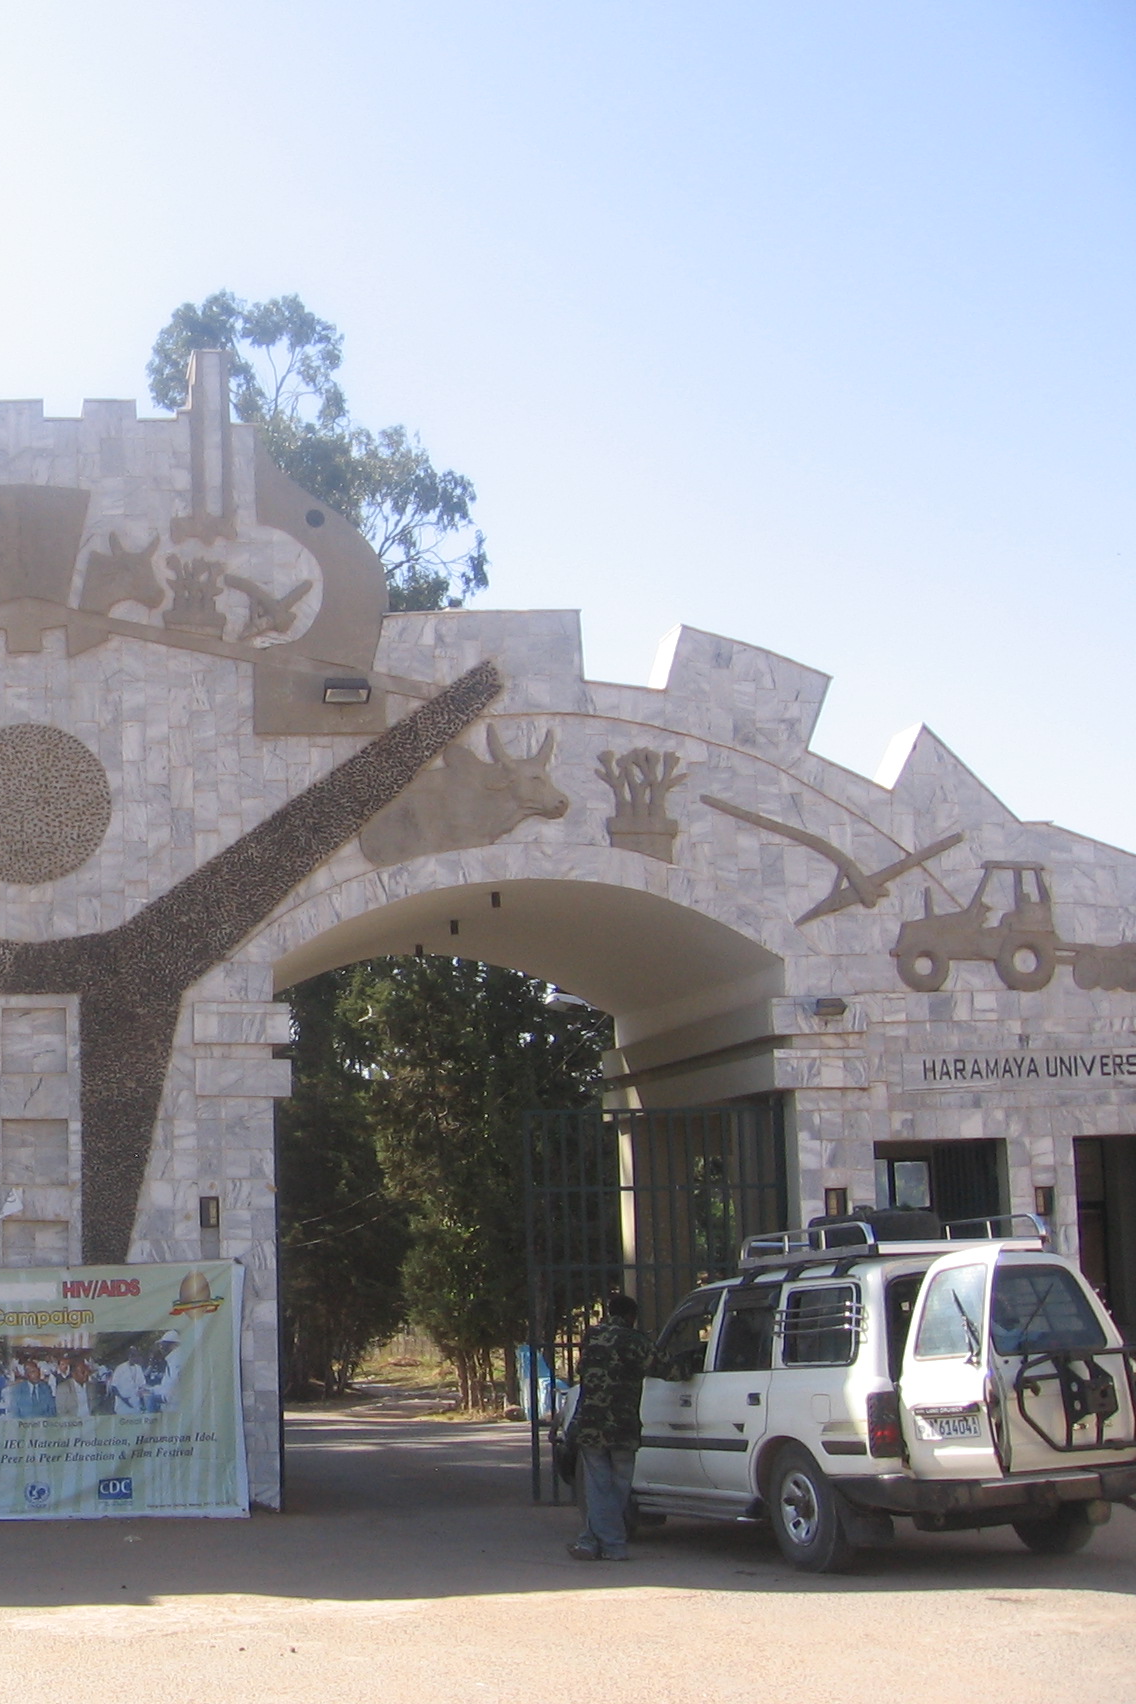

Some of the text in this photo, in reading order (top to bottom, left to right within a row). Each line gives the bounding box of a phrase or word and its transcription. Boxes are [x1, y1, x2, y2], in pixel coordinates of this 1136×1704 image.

[922, 1056, 1040, 1081] HARAMAYA
[62, 1278, 141, 1299] HIV/AIDS
[4, 1439, 25, 1449] IEC
[30, 1438, 70, 1449] Material
[74, 1436, 131, 1448] Production,
[0, 1454, 22, 1464] Peer
[26, 1454, 36, 1463] to
[39, 1453, 61, 1463] Peer
[64, 1452, 115, 1462] Education
[118, 1451, 127, 1460] &
[130, 1449, 153, 1459] Film
[155, 1447, 194, 1458] Festival
[100, 1479, 130, 1494] CDC
